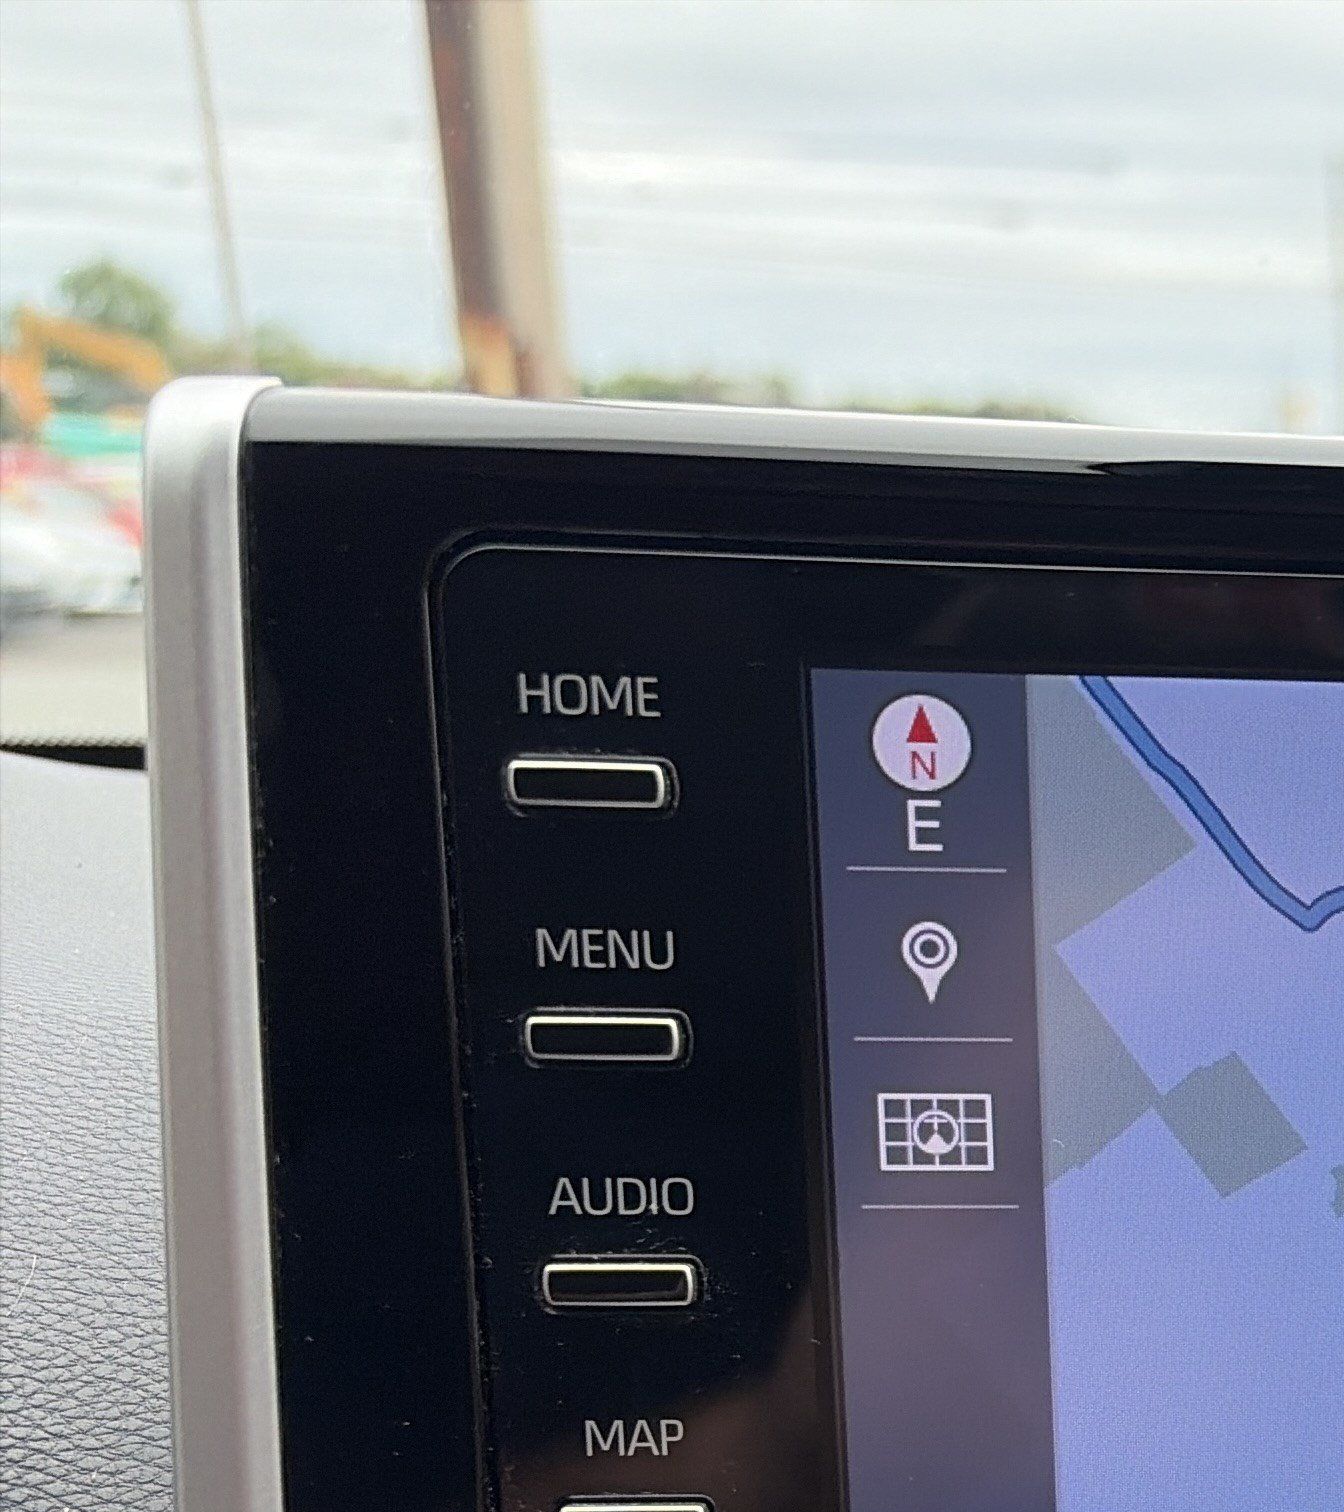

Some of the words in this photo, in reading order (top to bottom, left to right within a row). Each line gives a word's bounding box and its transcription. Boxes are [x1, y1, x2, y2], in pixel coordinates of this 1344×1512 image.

[518, 673, 661, 717] HOME
[909, 751, 938, 781] N
[907, 800, 944, 853] E
[534, 928, 675, 971] MENU
[547, 1177, 696, 1216] AUDIO
[583, 1418, 685, 1457] MAP
